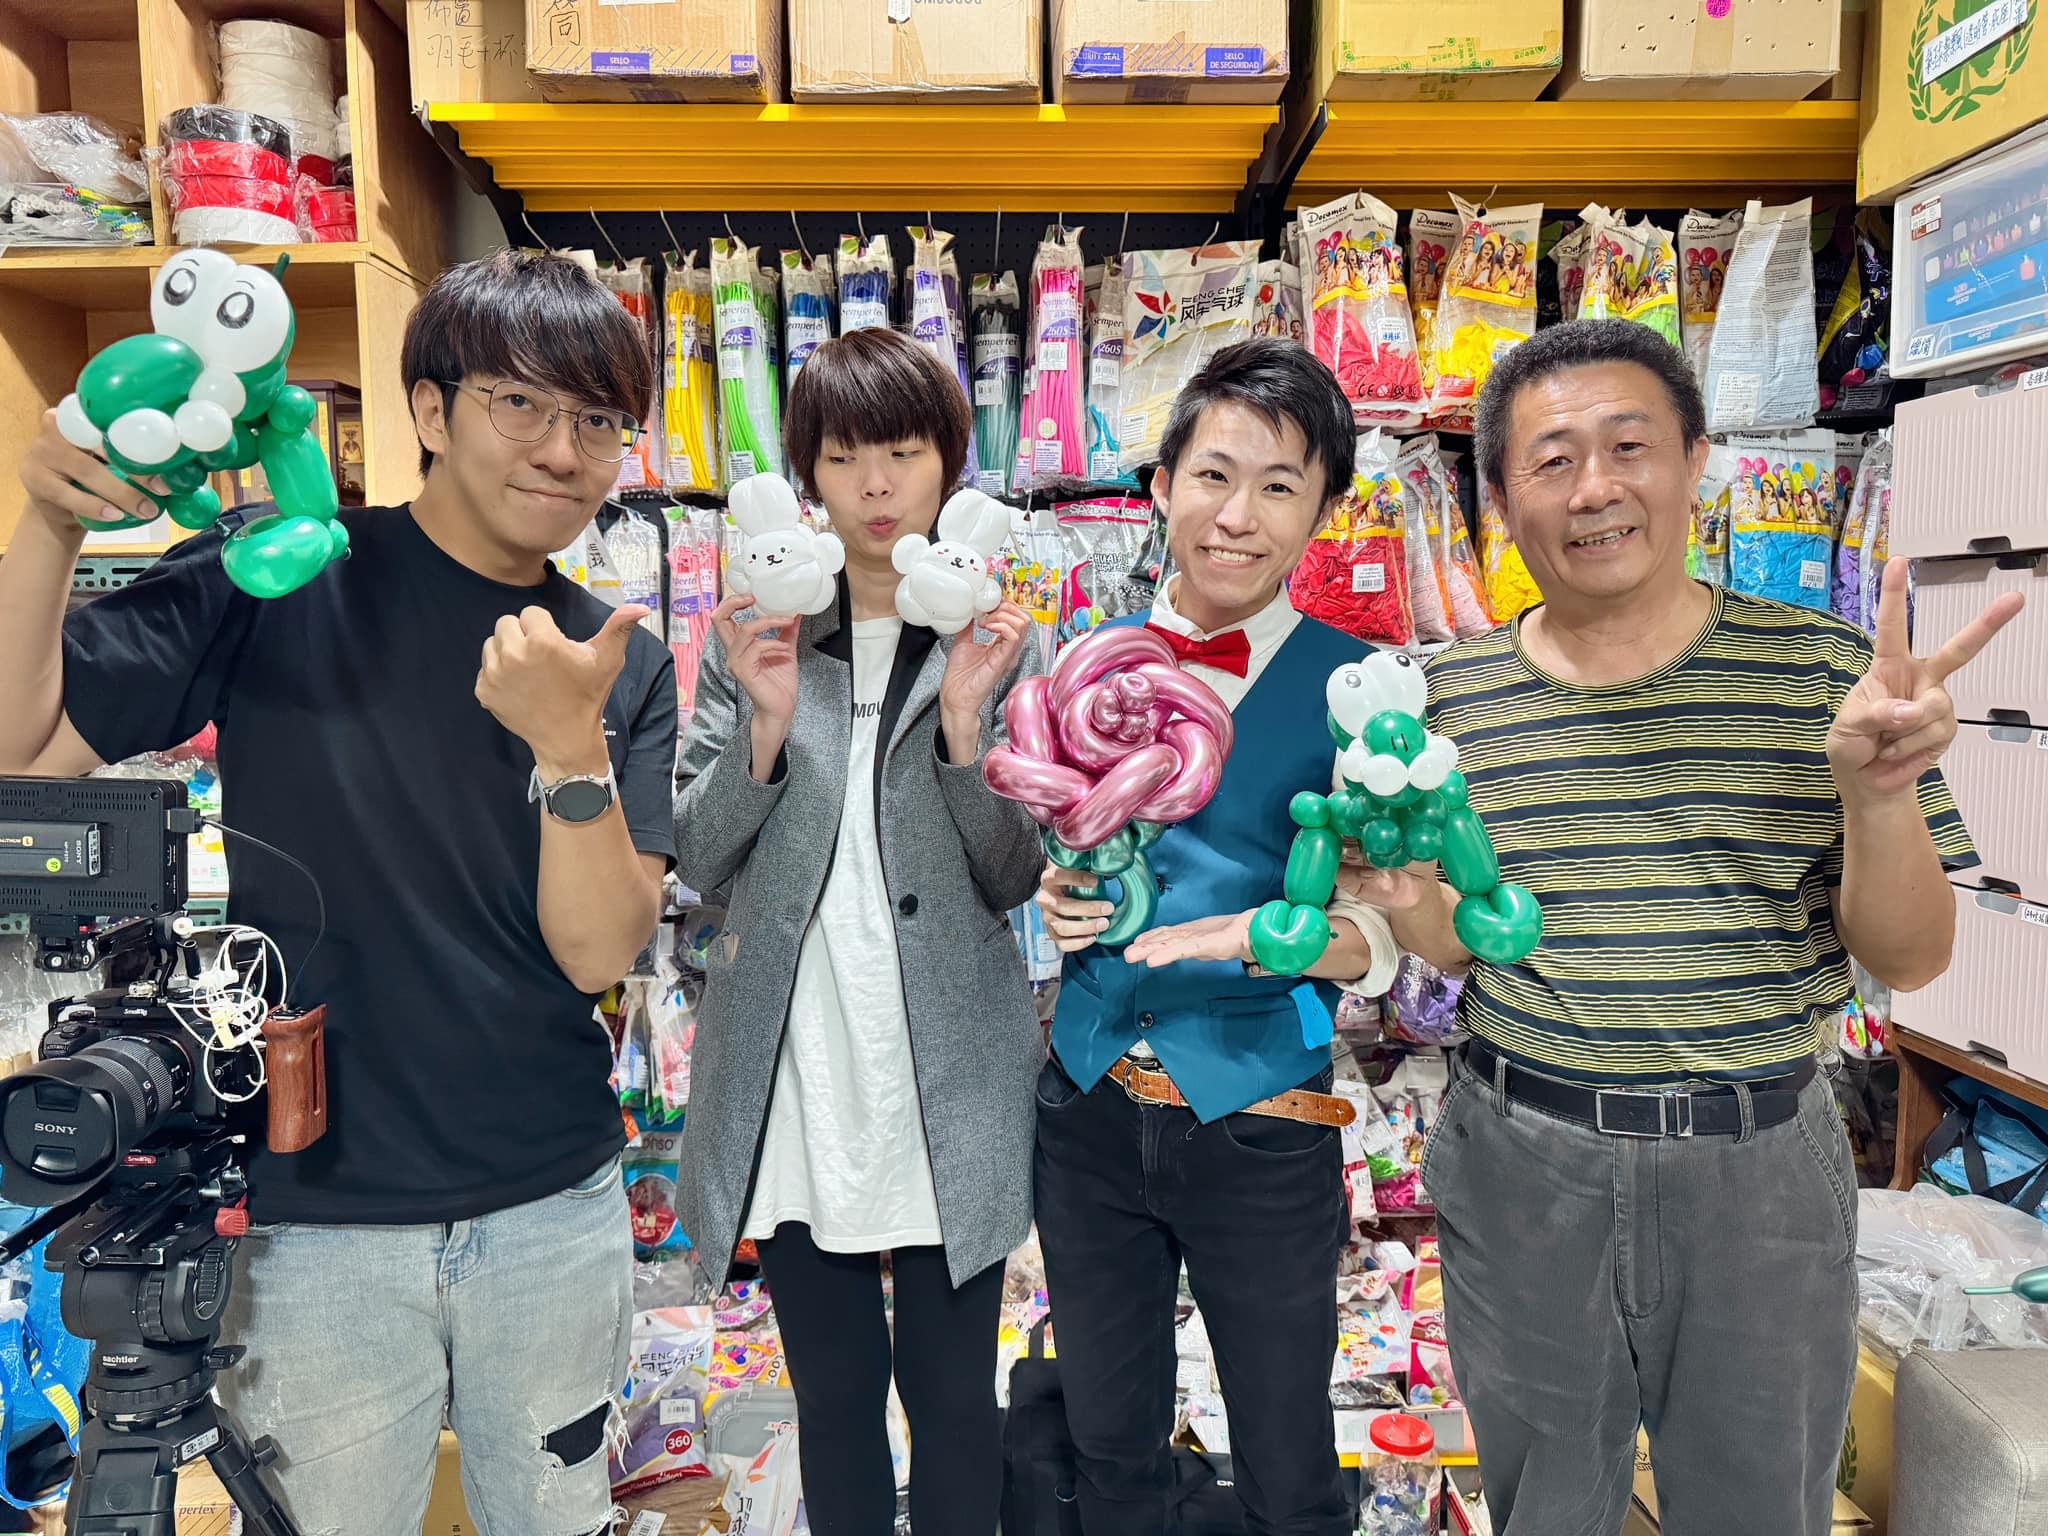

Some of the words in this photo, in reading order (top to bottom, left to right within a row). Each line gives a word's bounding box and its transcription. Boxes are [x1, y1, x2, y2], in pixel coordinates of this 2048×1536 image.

[610, 57, 630, 65] SELLO
[1224, 52, 1244, 60] SELLO
[1220, 61, 1259, 69] SEGURIDAD
[1217, 283, 1247, 295] CHE
[1180, 292, 1245, 323] 风车气球
[1099, 343, 1123, 355] 260S
[34, 1122, 78, 1135] SONY
[102, 1355, 139, 1364] sachtler
[668, 1435, 690, 1450] 360
